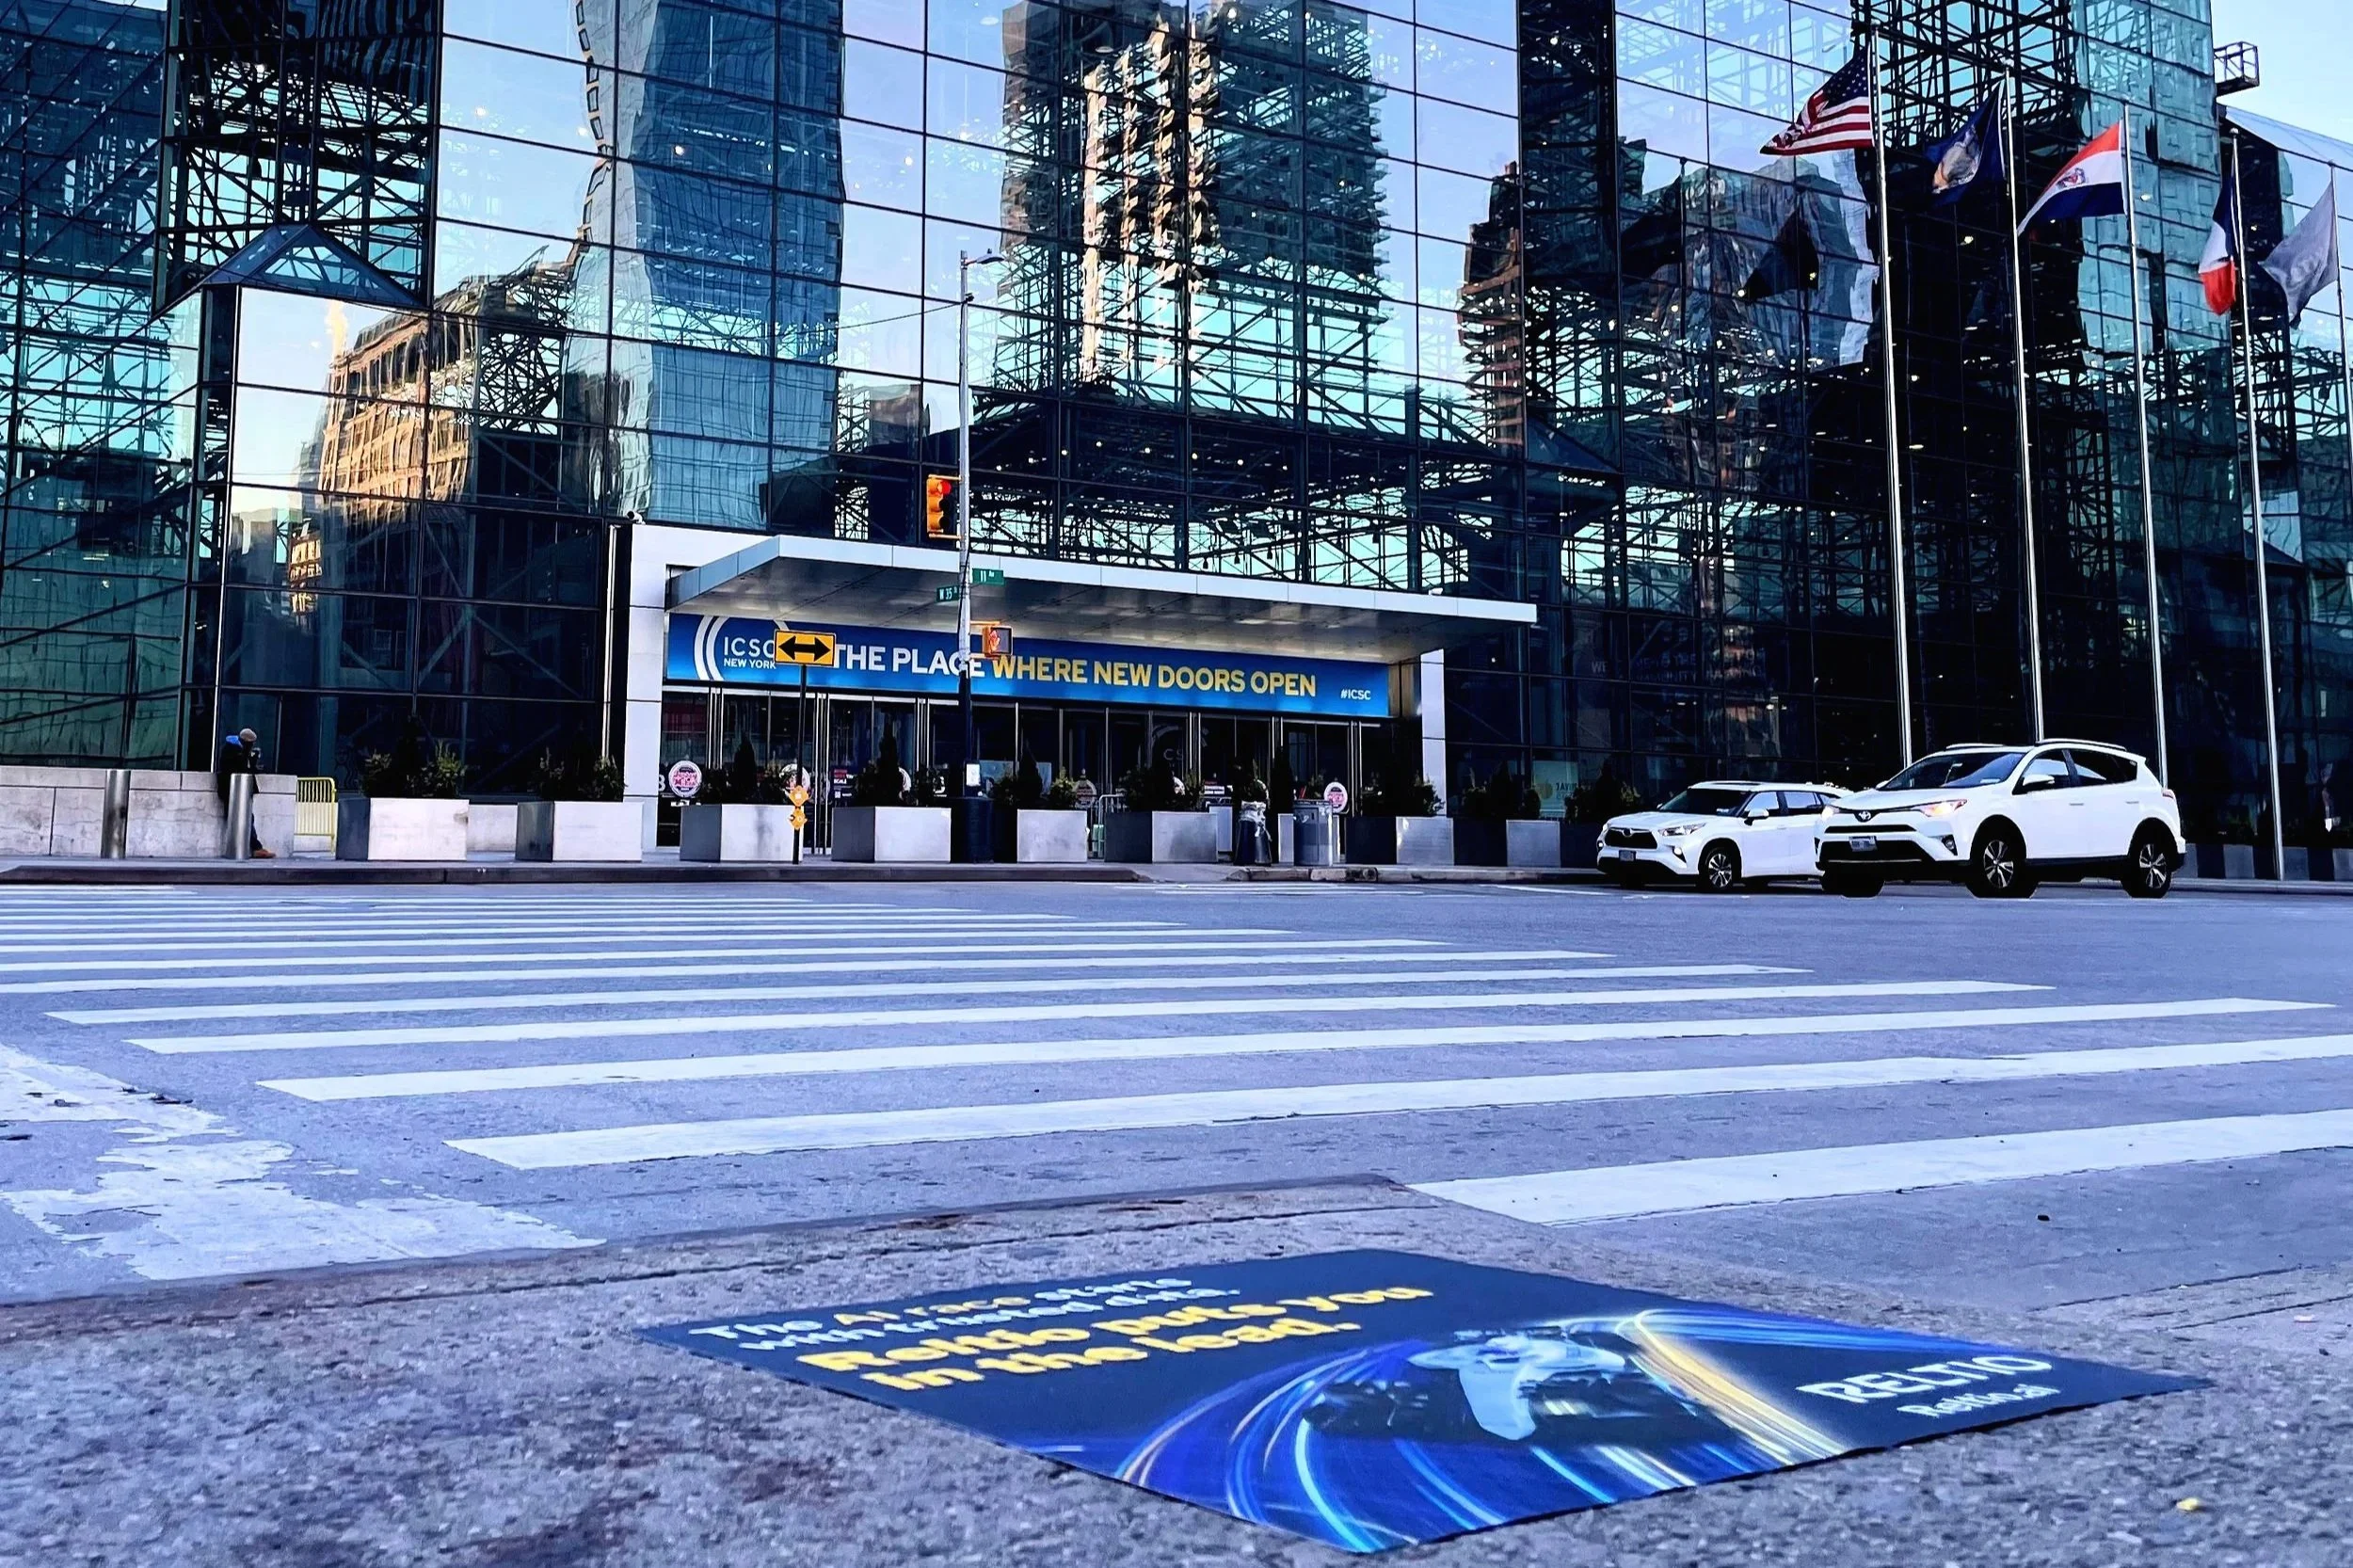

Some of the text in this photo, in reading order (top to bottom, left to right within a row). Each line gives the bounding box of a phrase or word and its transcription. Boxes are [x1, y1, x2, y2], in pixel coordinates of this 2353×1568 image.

[939, 588, 945, 600] W
[945, 587, 952, 600] 35
[981, 570, 986, 583] 11
[723, 658, 776, 669] NEW YORK
[992, 655, 1088, 683] WHERE
[1094, 661, 1153, 687] NEW
[1158, 665, 1245, 693] DOORS
[1250, 671, 1316, 697] OPEN
[1340, 688, 1371, 700] #ICSC
[688, 1278, 1193, 1339] The AI race starts
[738, 1288, 1241, 1351] with trusted data.
[795, 1287, 1434, 1372] Reltio puts you
[975, 1346, 1148, 1374] the
[1131, 1318, 1362, 1353] lead.
[1796, 1356, 2053, 1403] RELTIO
